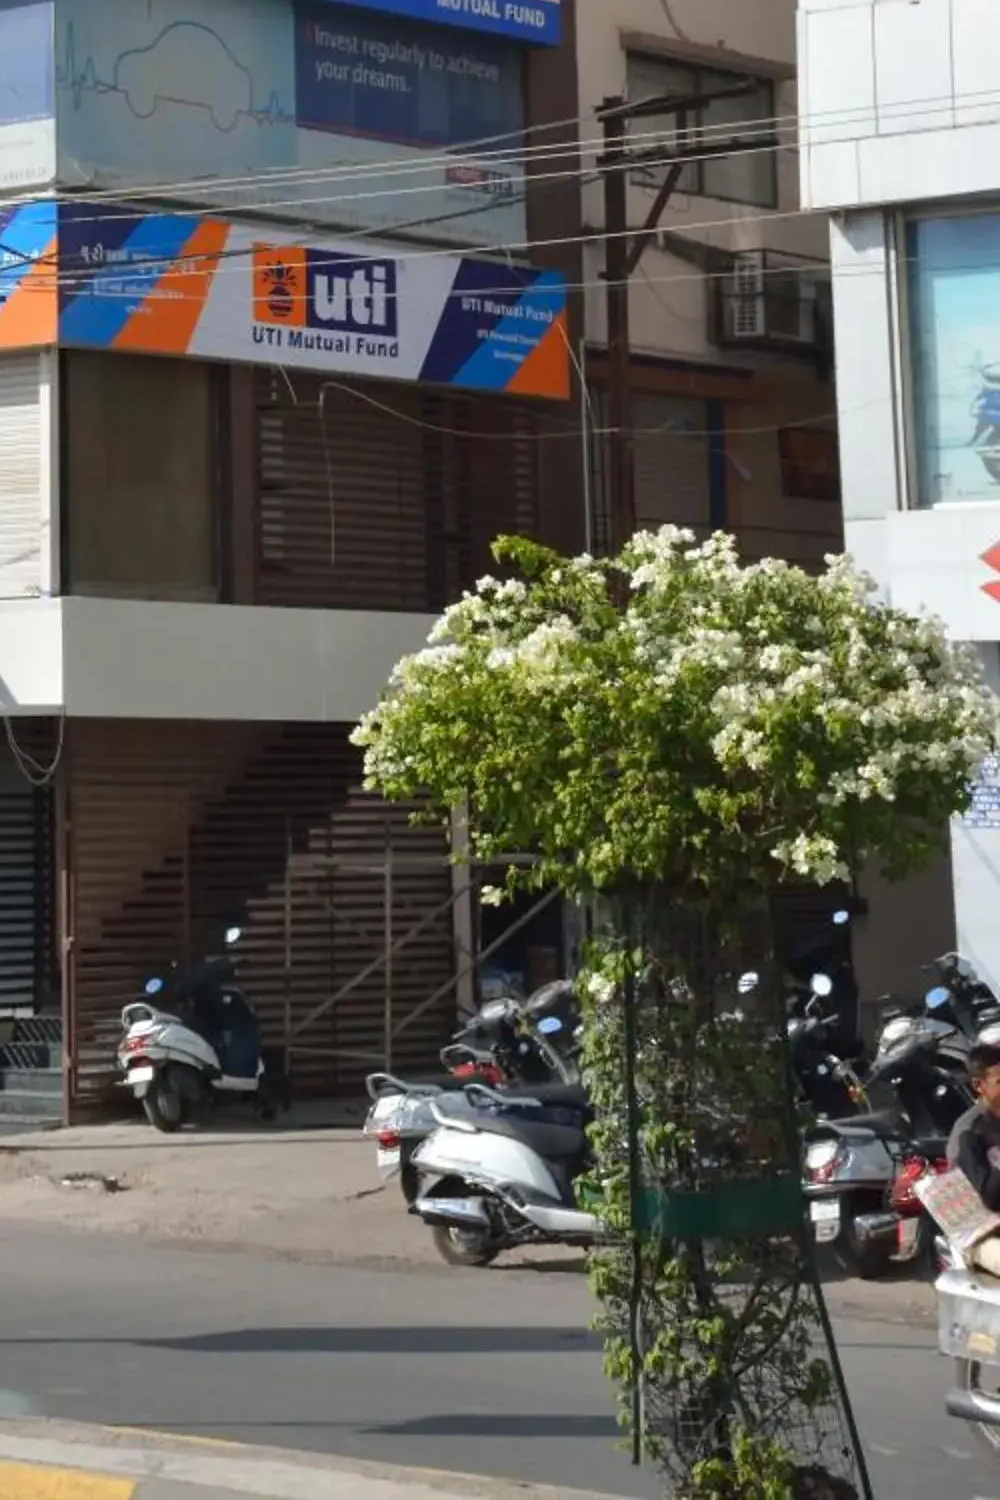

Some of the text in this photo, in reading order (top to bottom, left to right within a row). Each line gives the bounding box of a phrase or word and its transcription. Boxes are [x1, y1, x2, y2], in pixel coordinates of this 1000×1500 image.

[504, 3, 546, 29] FUND
[312, 24, 358, 54] Invest
[361, 39, 424, 70] regularly
[428, 52, 445, 71] to
[314, 60, 350, 84] your
[313, 265, 387, 327] uti
[251, 325, 400, 358] UTI Mutual Fund
